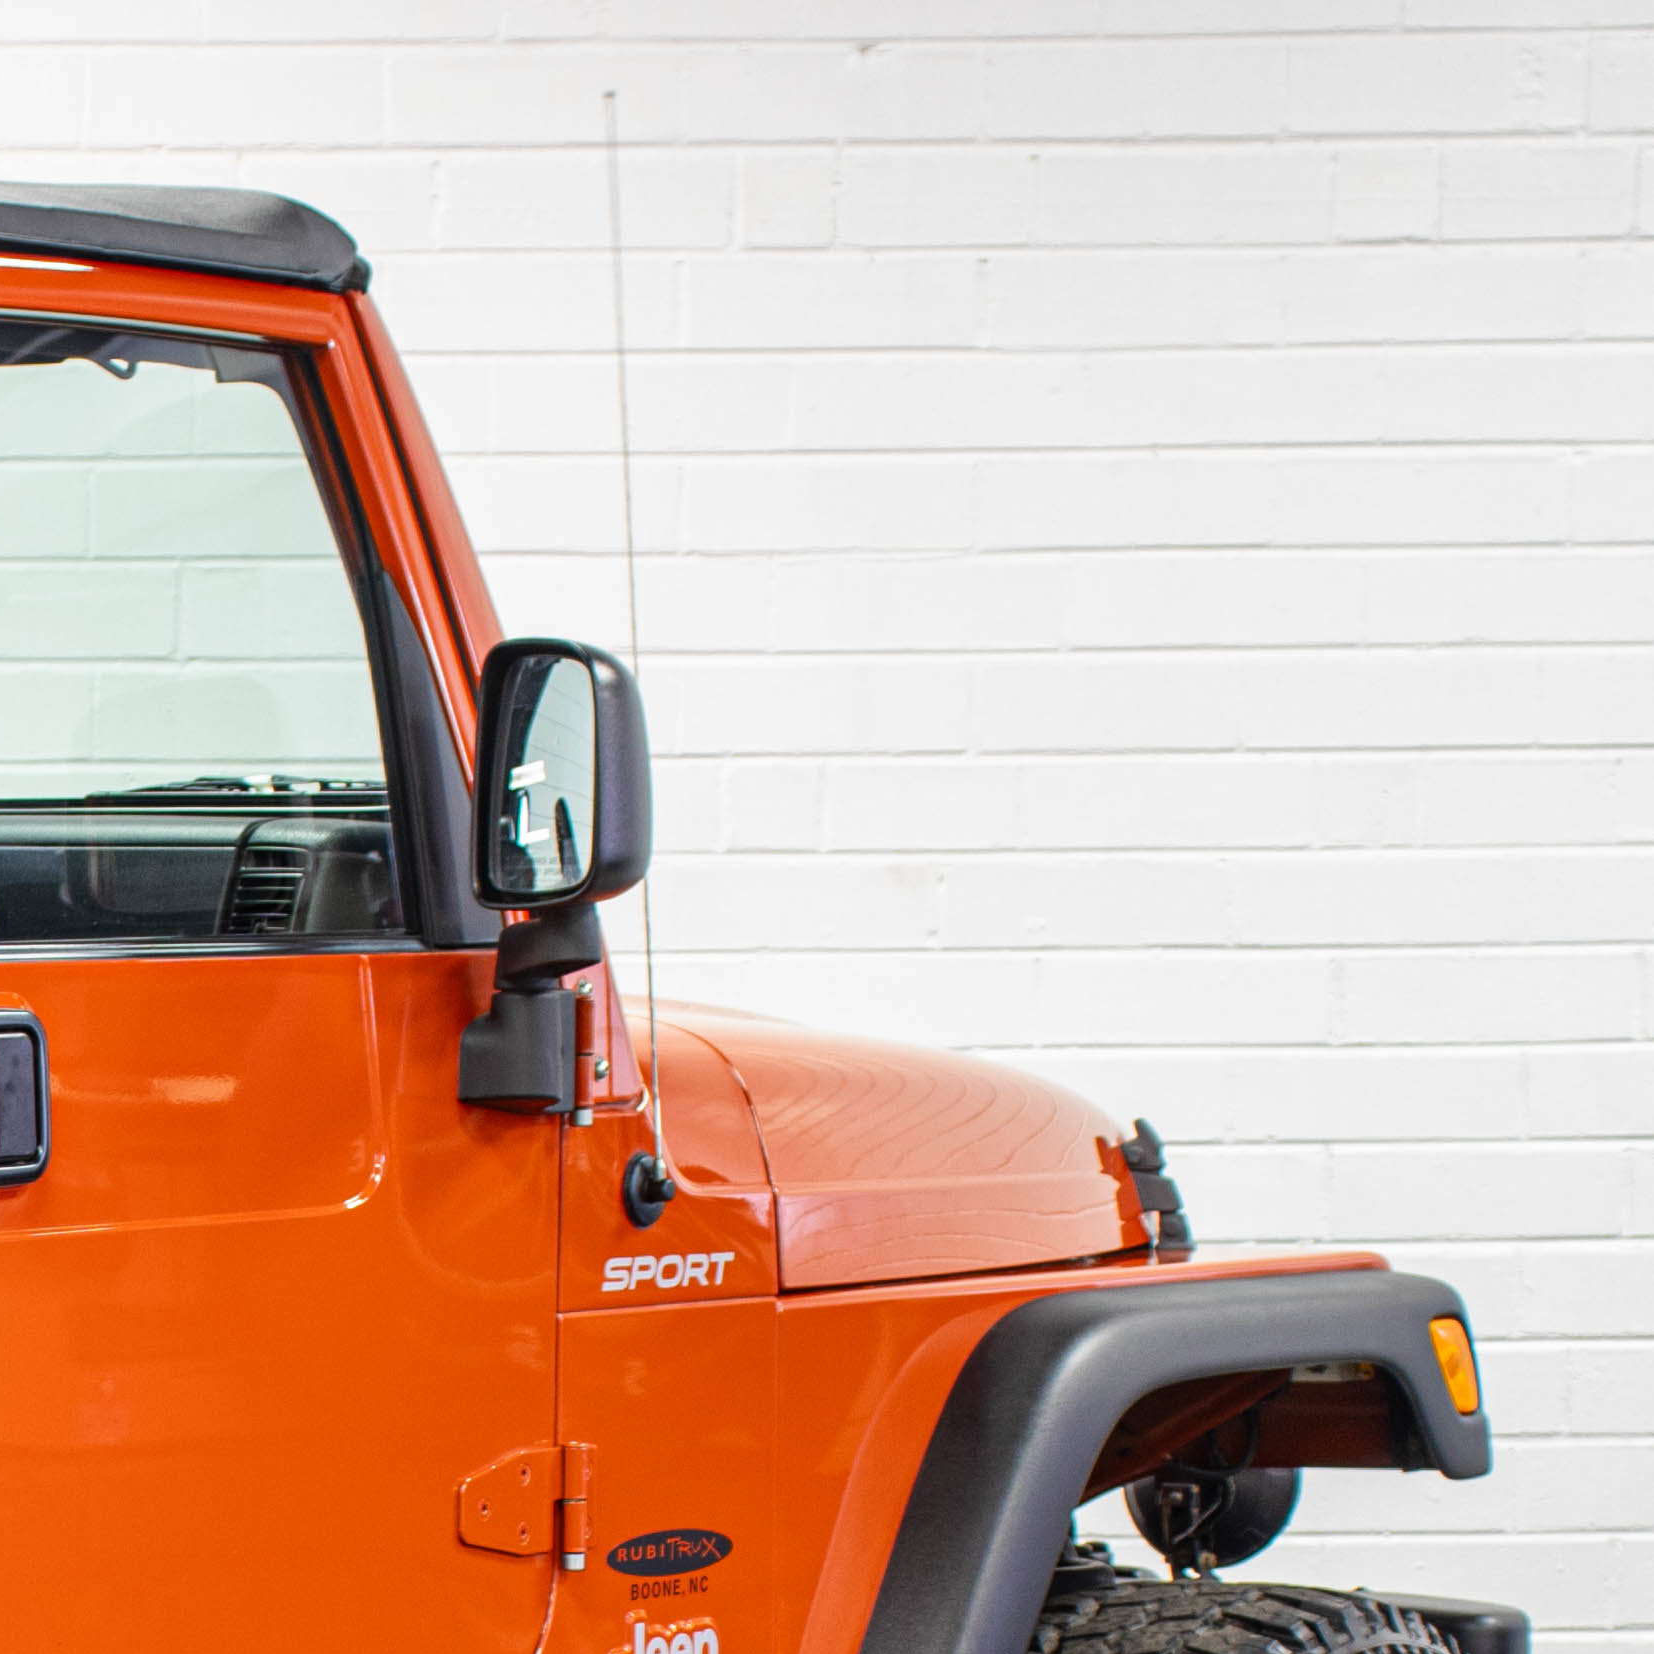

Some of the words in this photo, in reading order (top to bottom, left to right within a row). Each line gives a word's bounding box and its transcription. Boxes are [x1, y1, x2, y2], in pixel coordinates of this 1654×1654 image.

[601, 1251, 736, 1292] SPORT
[630, 1579, 686, 1600] BOONE,
[689, 1576, 709, 1593] NC
